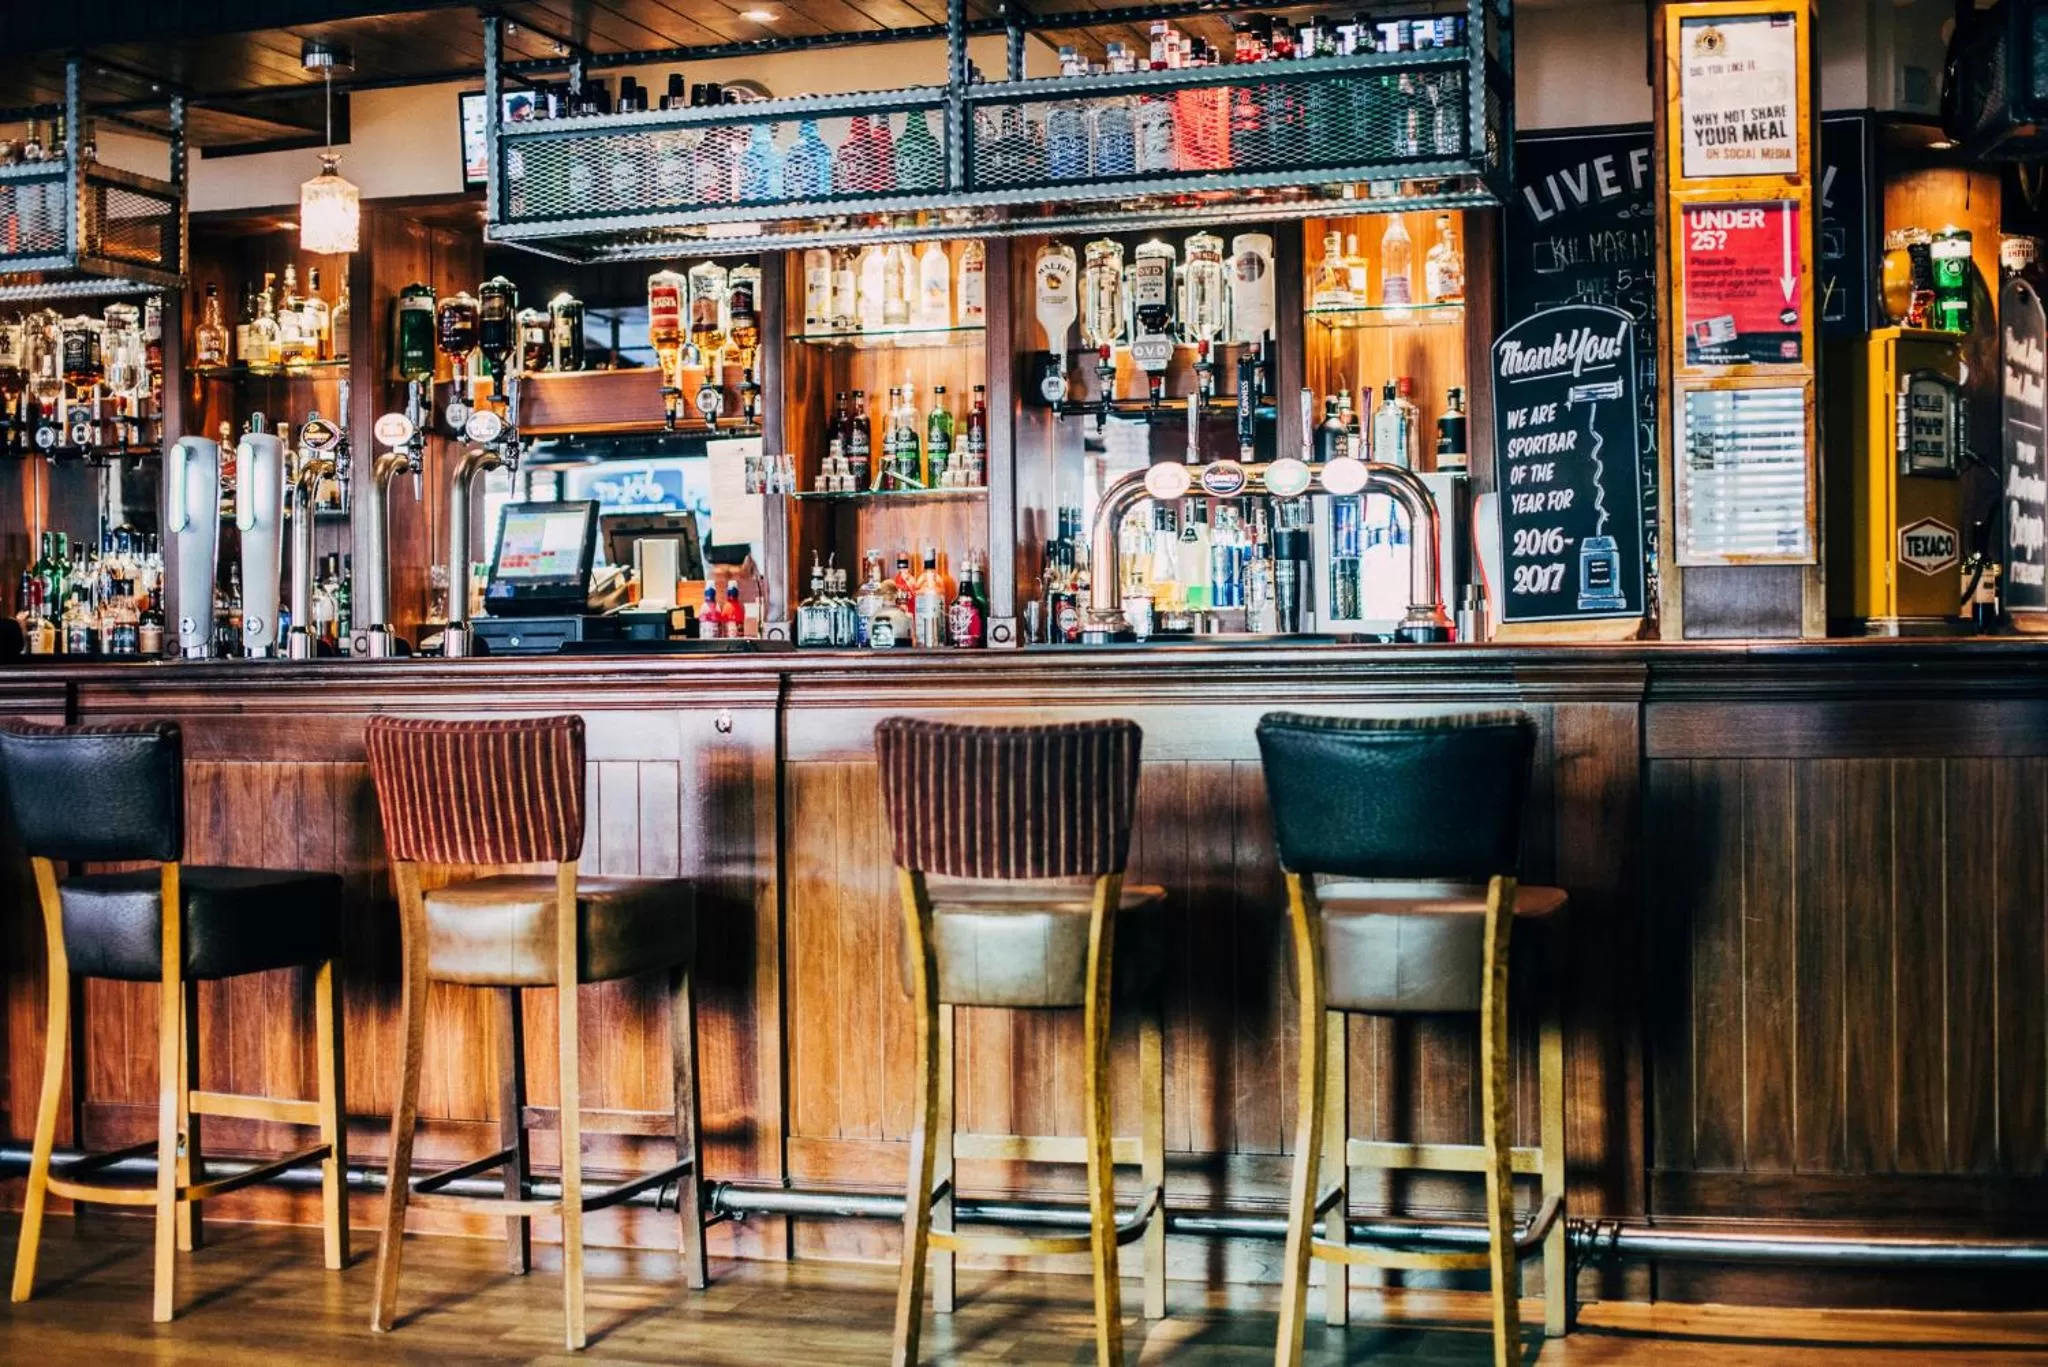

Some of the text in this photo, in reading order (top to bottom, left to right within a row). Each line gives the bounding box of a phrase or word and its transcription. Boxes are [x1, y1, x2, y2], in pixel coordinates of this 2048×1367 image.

[1692, 104, 1787, 126] WHY NOT SHARE
[1694, 120, 1788, 147] YOUR MEAL
[1724, 147, 1756, 160] SOCIAL
[1761, 147, 1791, 160] MEDIA
[1523, 154, 1622, 222] LIVE
[1690, 209, 1765, 230] UNDER
[1690, 231, 1728, 251] 25?
[1134, 345, 1166, 355] OVD
[1507, 402, 1558, 430] WE ARE
[1507, 430, 1578, 459] SPORTBAR
[1510, 462, 1556, 485] OF THE
[1511, 488, 1575, 515] YEAR FOR
[1512, 527, 1575, 557] 2016-
[1906, 535, 1953, 557] TEXACO
[1512, 562, 1566, 594] 2017
